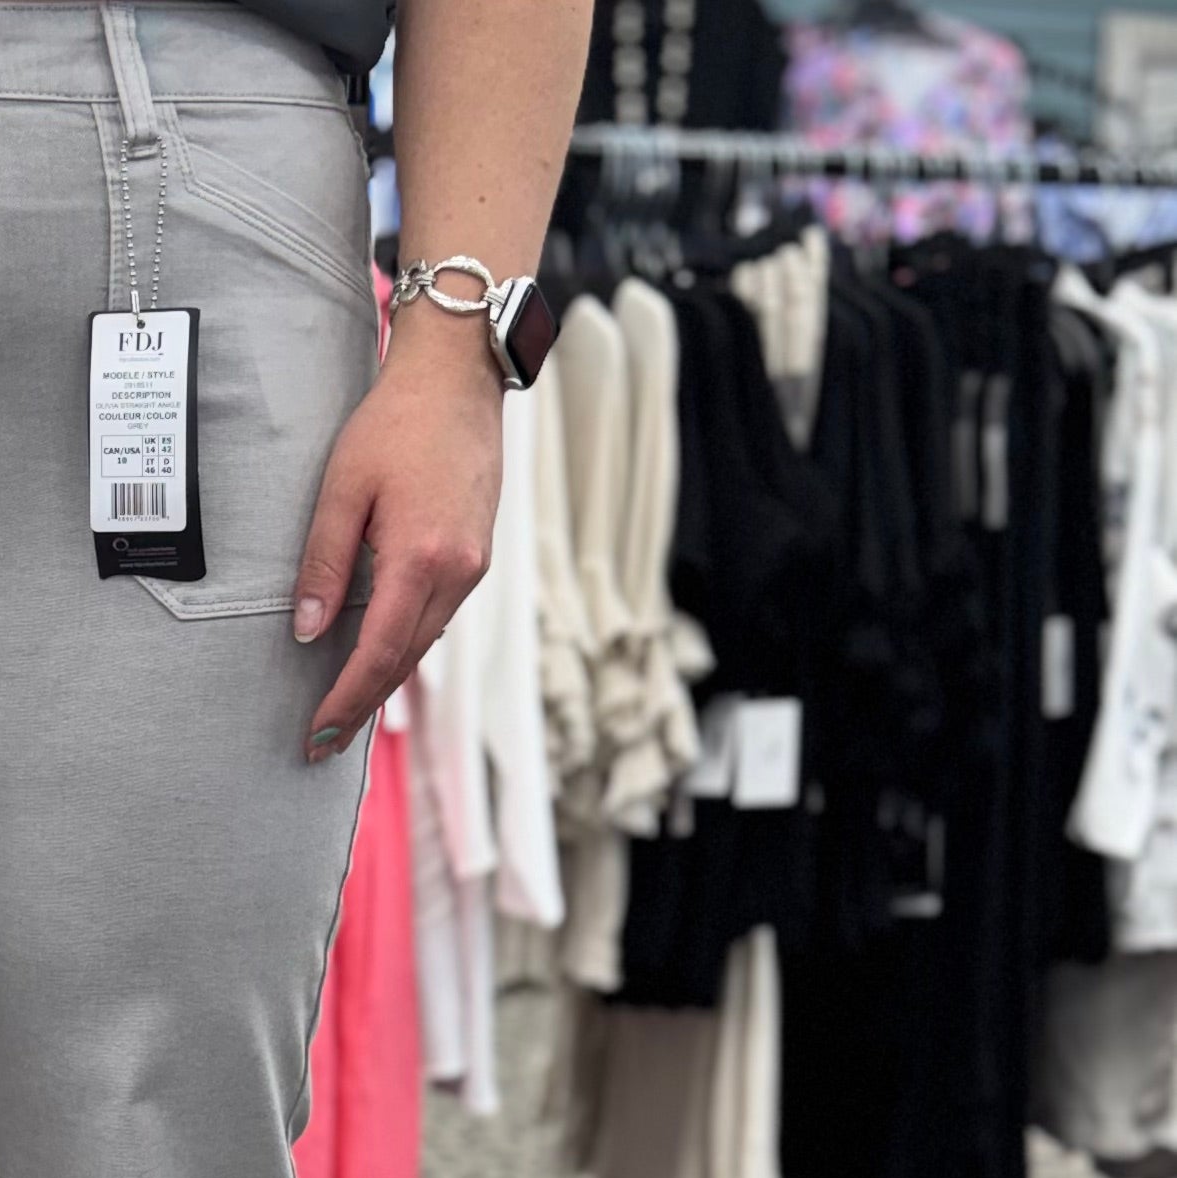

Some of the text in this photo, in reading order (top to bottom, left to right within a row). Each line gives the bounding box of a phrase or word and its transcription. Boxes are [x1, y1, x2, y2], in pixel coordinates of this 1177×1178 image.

[119, 331, 165, 352] FDJ
[102, 371, 140, 380] MODELE
[147, 370, 175, 379] STYLE
[111, 391, 172, 400] DESCRIPTION
[144, 437, 157, 445] UK
[145, 446, 156, 454] 14
[145, 458, 155, 466] IT
[161, 466, 173, 474] 40
